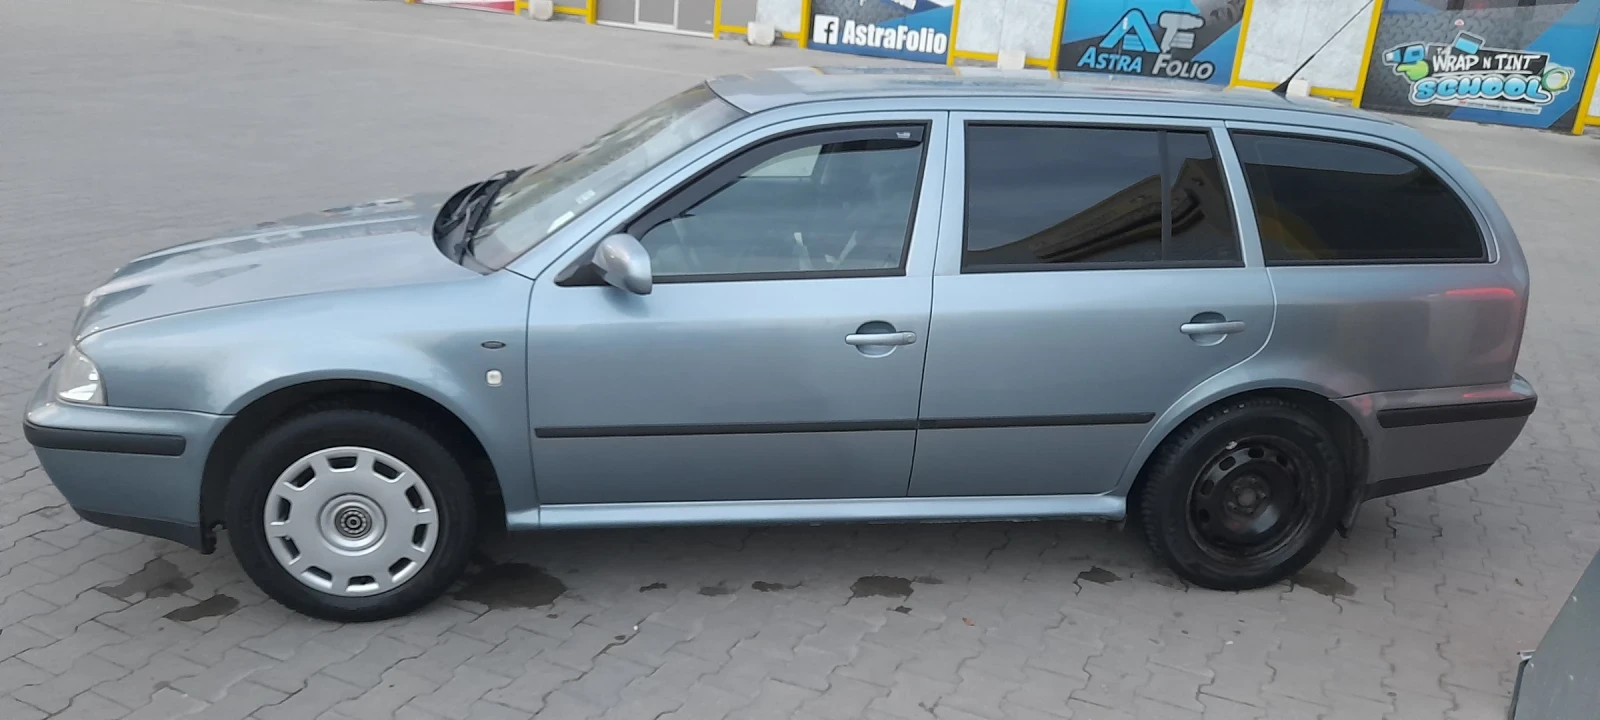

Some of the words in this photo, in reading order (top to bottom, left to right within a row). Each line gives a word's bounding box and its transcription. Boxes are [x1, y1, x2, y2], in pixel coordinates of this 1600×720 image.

[841, 19, 948, 55] AstraFolio
[1077, 46, 1142, 73] ASTRA
[1152, 53, 1215, 80] FOLIO
[1432, 53, 1479, 73] WRAP
[1482, 55, 1492, 70] N
[1494, 53, 1541, 72] TINT
[1414, 75, 1549, 102] SCHOOL
